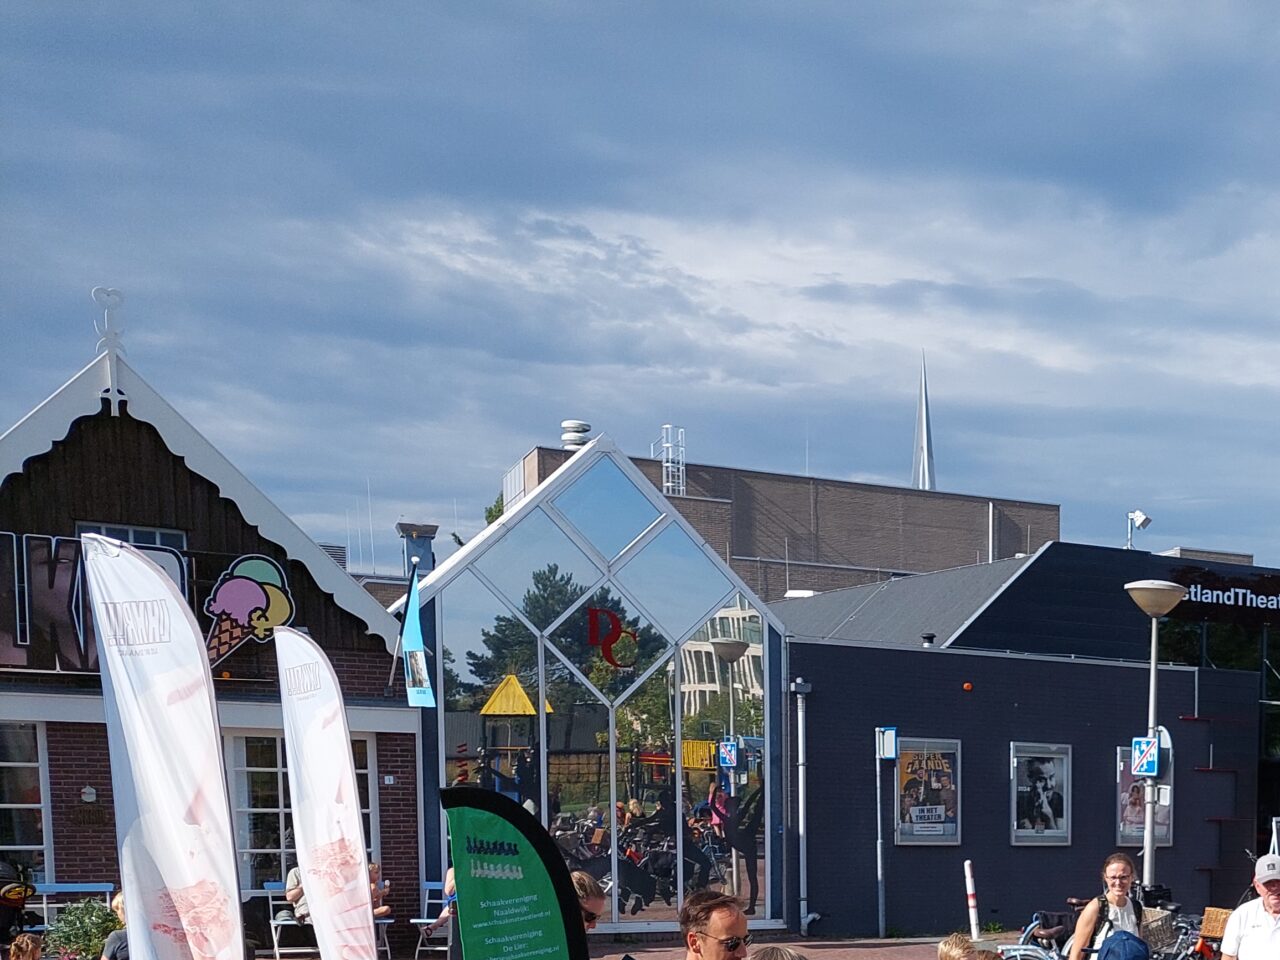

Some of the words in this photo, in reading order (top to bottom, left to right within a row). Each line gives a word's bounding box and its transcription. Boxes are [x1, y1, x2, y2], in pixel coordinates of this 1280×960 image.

[912, 752, 942, 760] SUPER
[905, 759, 952, 773] GAANDE
[915, 813, 942, 821] THEATER
